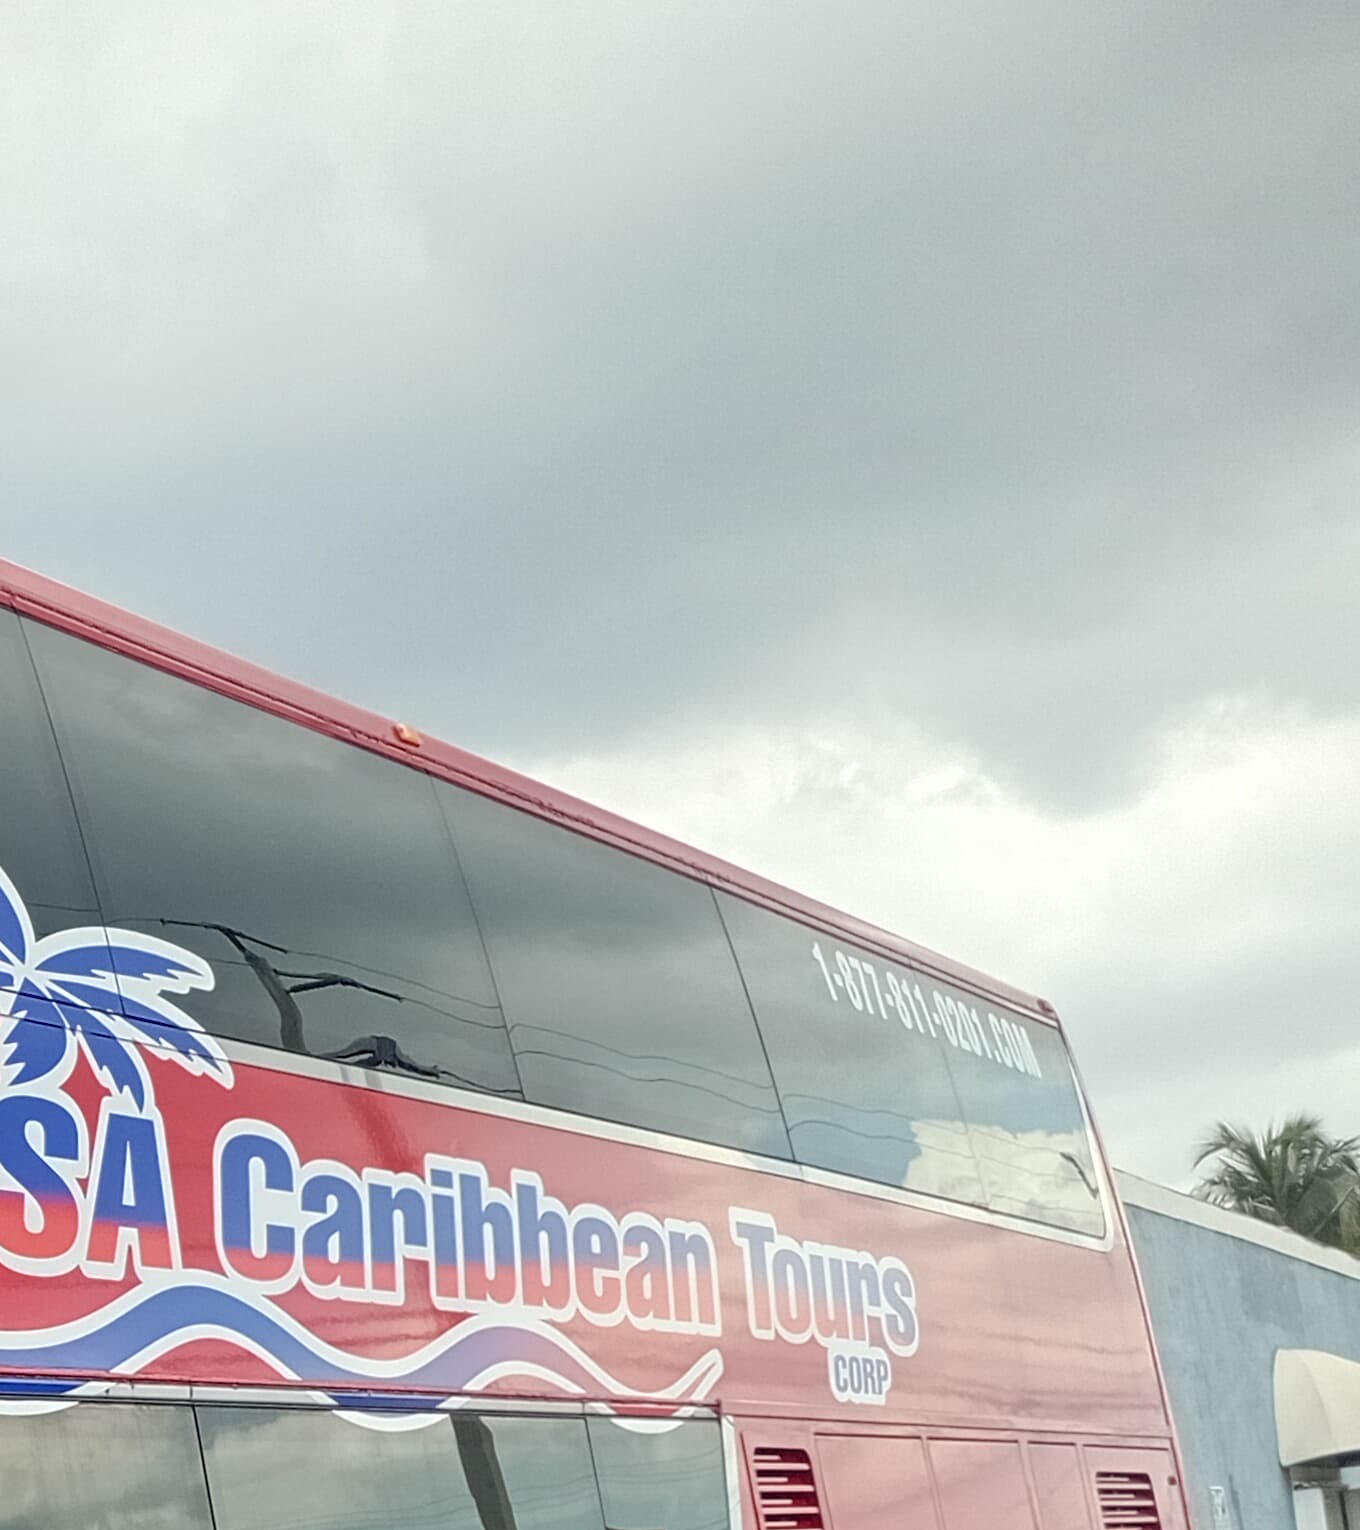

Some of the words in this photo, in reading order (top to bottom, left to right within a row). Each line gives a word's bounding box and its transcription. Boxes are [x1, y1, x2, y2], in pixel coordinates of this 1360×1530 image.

[217, 1124, 719, 1334] Caribbean
[733, 1213, 917, 1351] Tours
[834, 1354, 889, 1397] CORP
